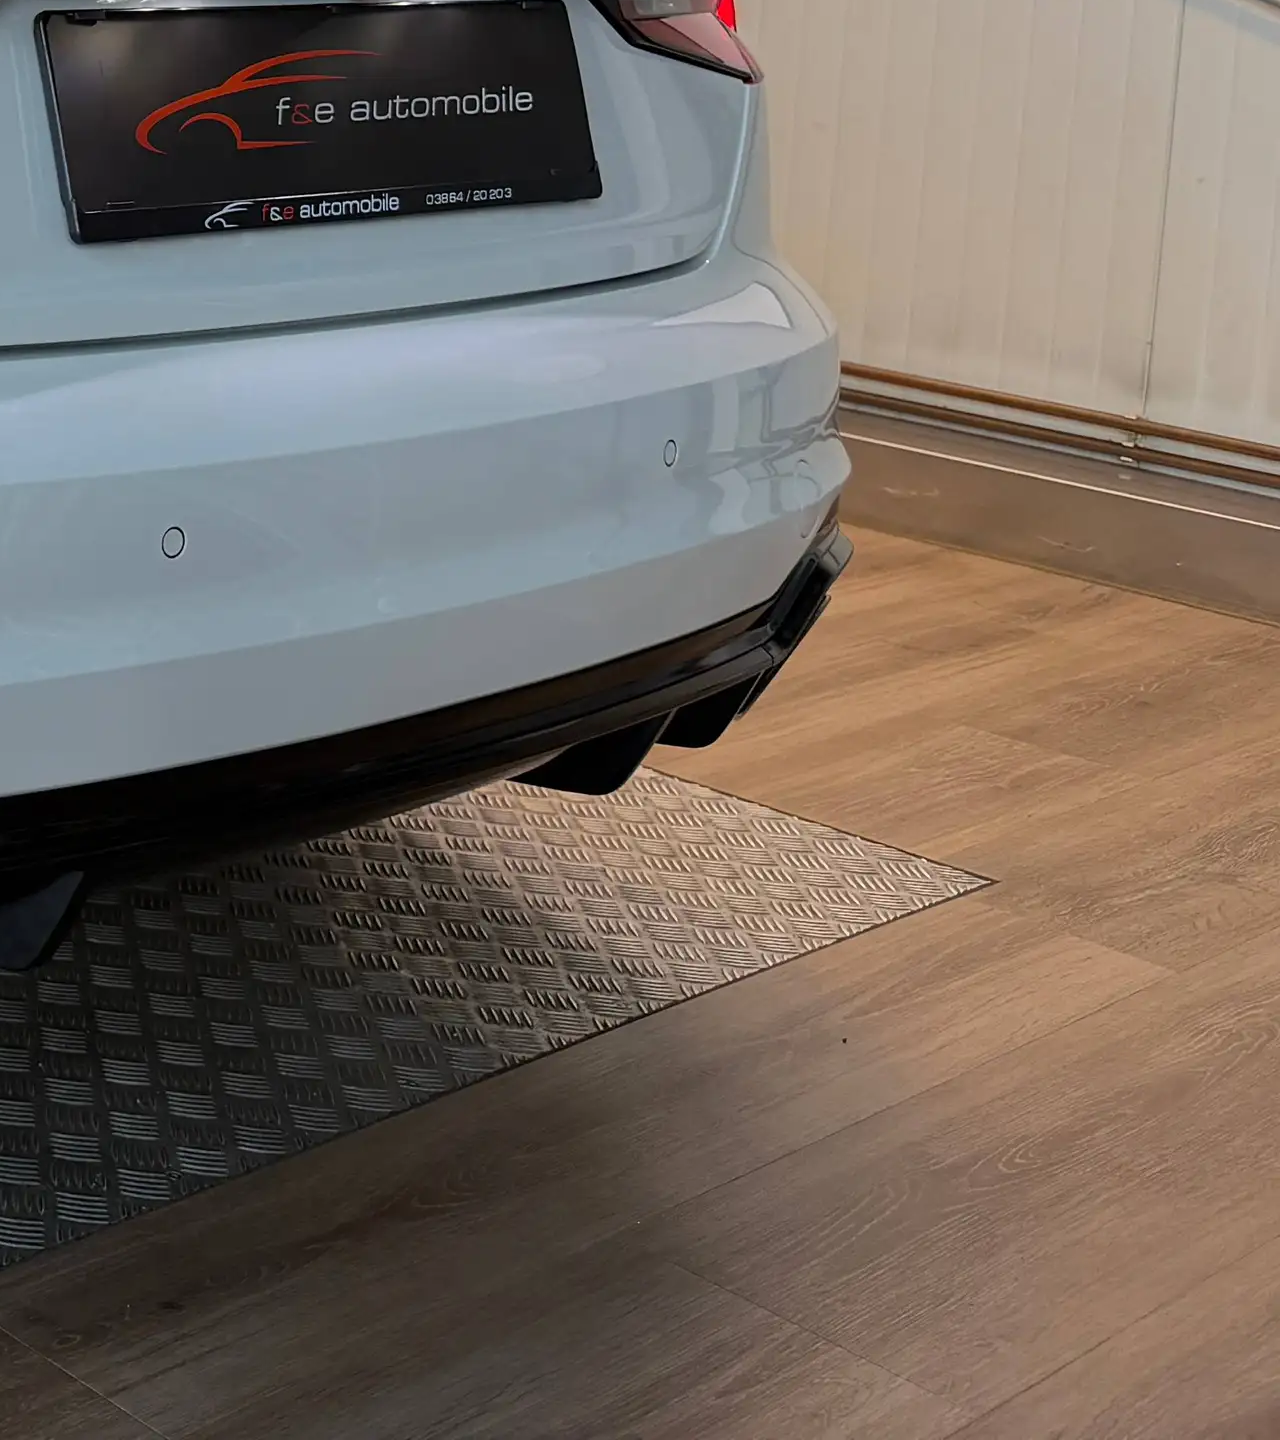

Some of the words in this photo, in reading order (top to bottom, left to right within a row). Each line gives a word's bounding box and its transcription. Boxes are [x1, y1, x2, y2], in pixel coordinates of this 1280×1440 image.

[275, 96, 335, 126] f&e
[349, 85, 534, 122] automobile
[261, 203, 294, 222] f&e
[299, 193, 400, 219] automobile
